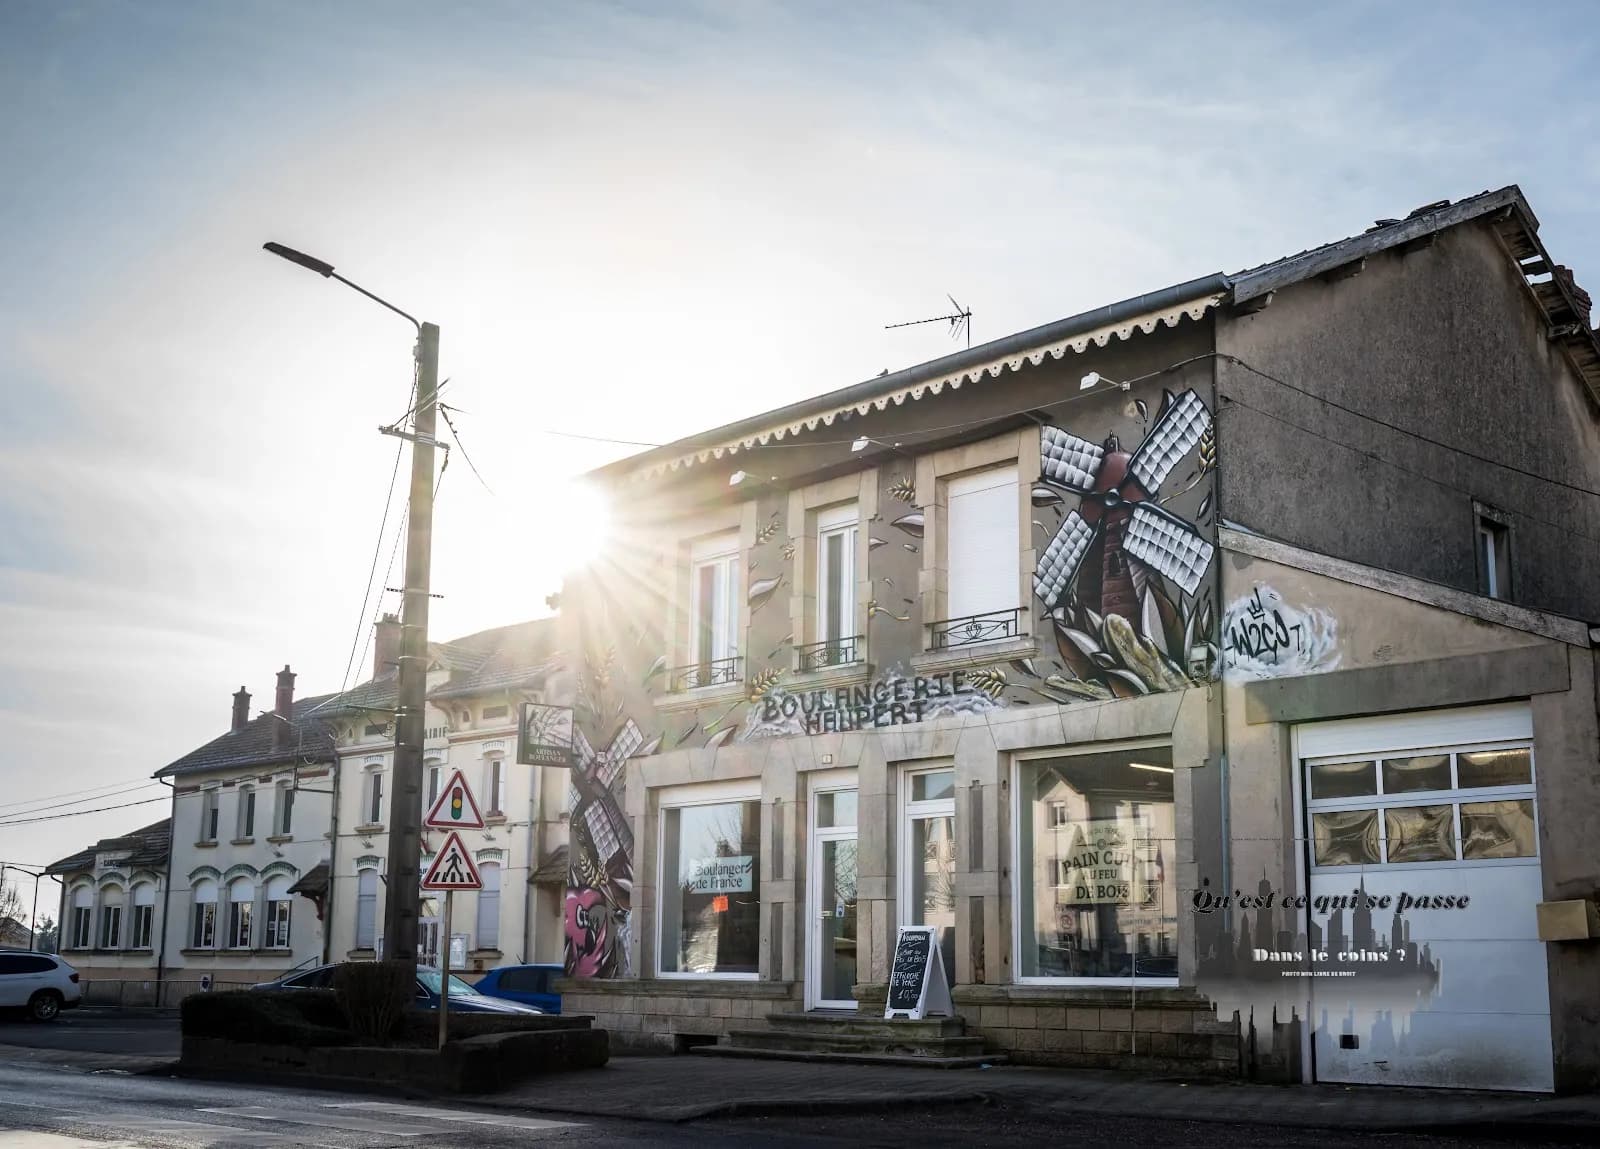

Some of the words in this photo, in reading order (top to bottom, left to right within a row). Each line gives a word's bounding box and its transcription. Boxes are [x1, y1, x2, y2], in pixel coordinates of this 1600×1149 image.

[762, 670, 975, 722] BOULANGERIE
[424, 726, 448, 739] AIRIE
[1062, 851, 1099, 875] PAIN
[696, 863, 745, 878] Boulanger
[1098, 868, 1117, 880] FEU
[696, 879, 708, 889] de
[710, 876, 743, 889] France
